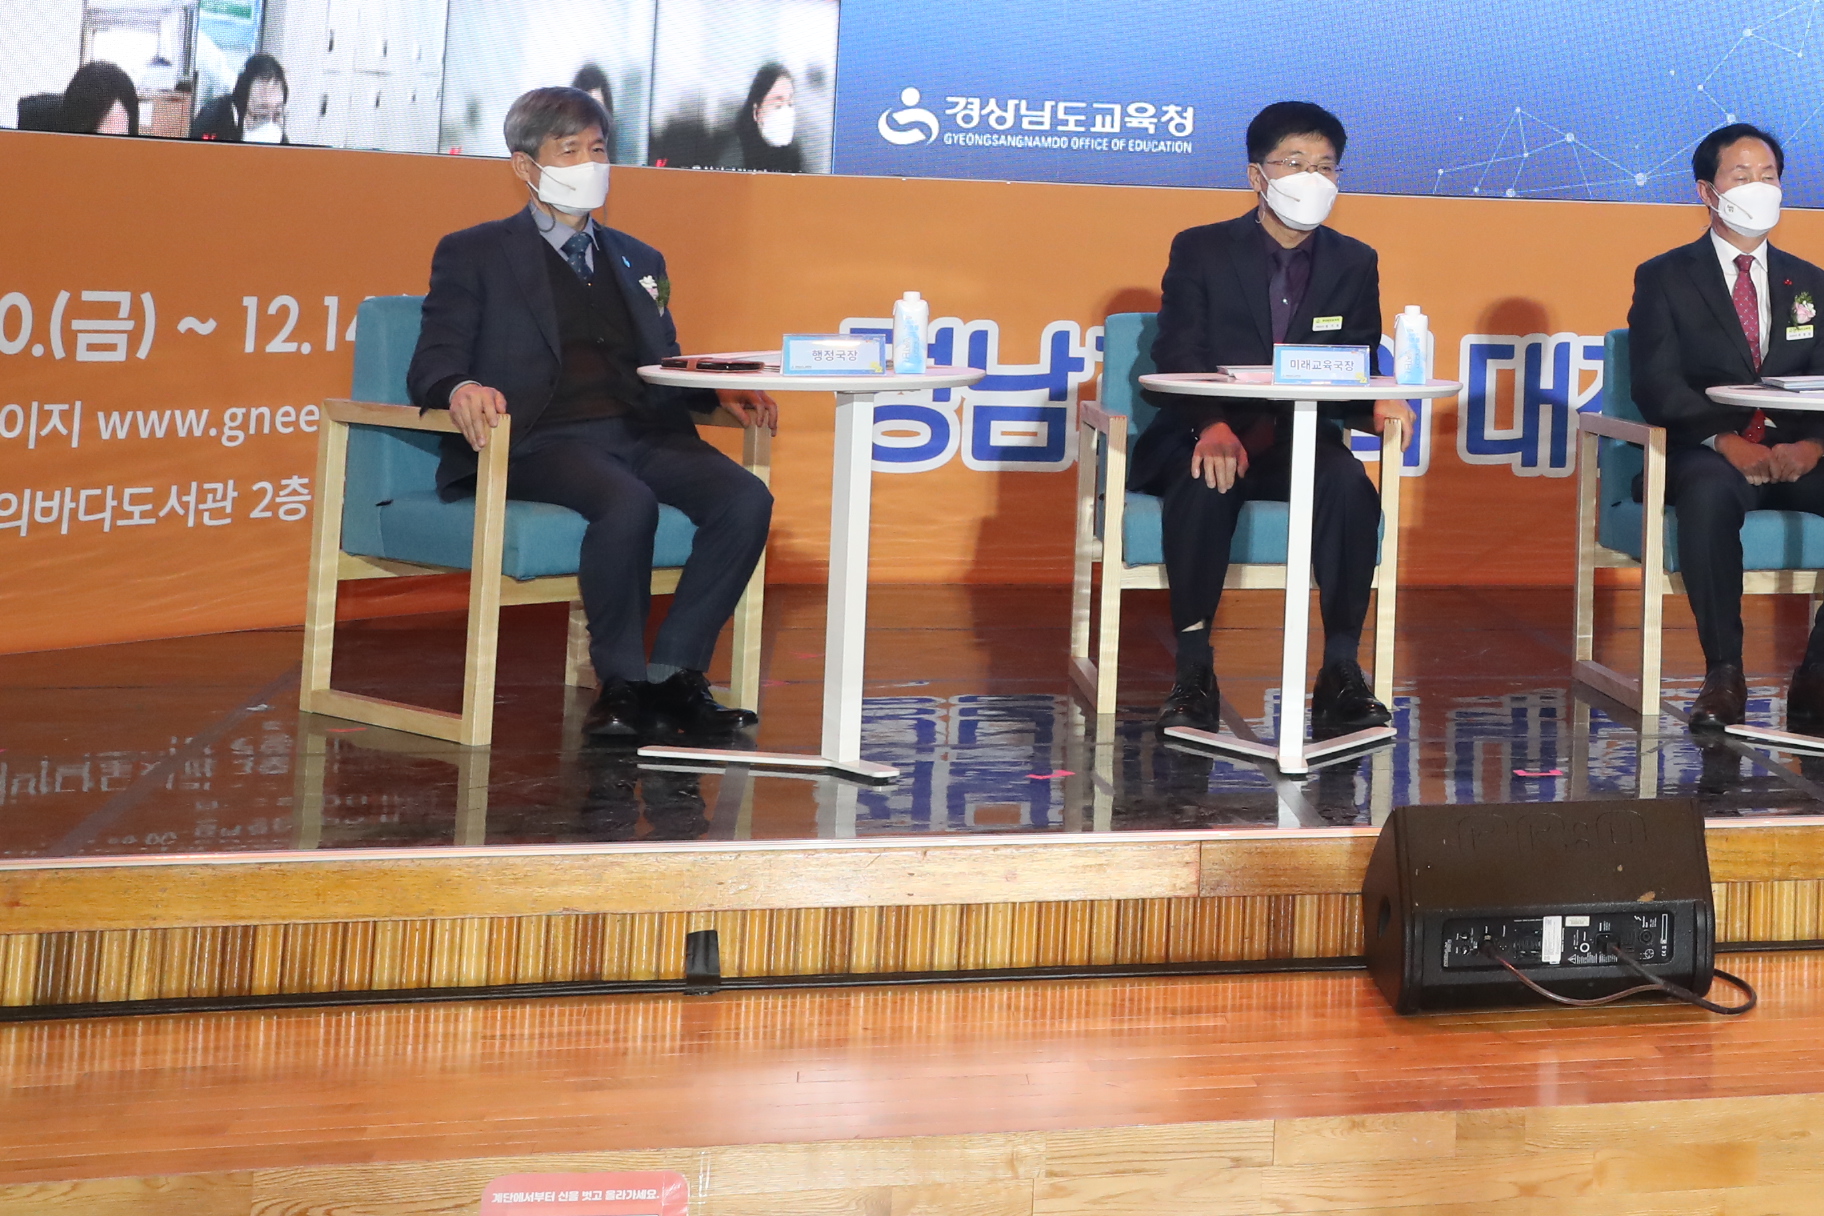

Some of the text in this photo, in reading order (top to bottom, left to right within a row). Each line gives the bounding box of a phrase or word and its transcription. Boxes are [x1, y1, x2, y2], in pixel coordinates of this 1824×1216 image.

[944, 95, 1195, 138] 경상남도교육청
[1070, 136, 1109, 152] OFFICE
[1111, 137, 1127, 152] OF
[1128, 138, 1192, 154] EDUCATION
[243, 294, 358, 354] 12.1
[812, 349, 858, 362] 행정국장
[1290, 358, 1355, 372] 미래교육국장
[0, 476, 312, 536] 의바다도서관 2층
[491, 1191, 556, 1204] 계단에서부터
[558, 1190, 579, 1202] 신을
[581, 1189, 603, 1202] 벗고
